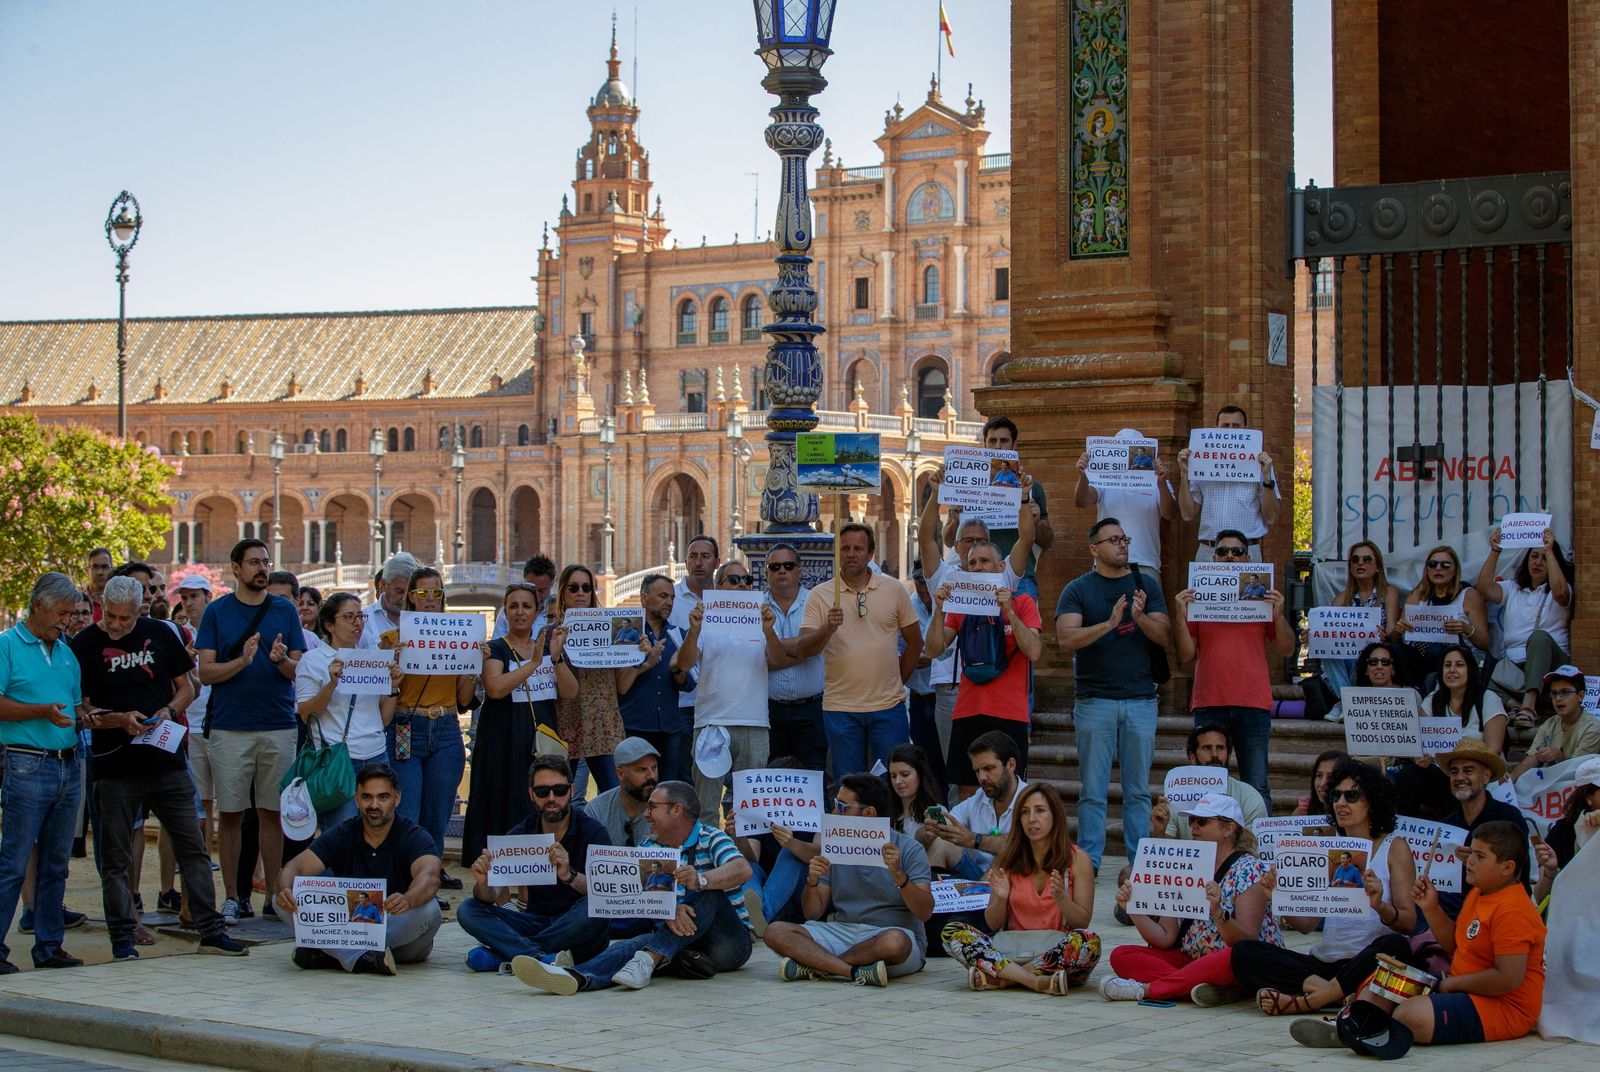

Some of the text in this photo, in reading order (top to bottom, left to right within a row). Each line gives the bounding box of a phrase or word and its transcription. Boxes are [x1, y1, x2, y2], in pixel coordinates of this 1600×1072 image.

[1201, 432, 1251, 440] SÁNCHEZ
[1194, 452, 1256, 460] ABENGOA
[946, 461, 989, 471] ¡¡CLARO
[946, 476, 987, 486] QUE SI!!
[1194, 578, 1237, 587] ¡¡CLARO
[707, 601, 759, 609] ¡¡ABENGOA
[706, 615, 760, 624] SOLUCIÓN!!
[1320, 610, 1369, 619] SÁNCHEZ
[414, 616, 472, 626] SÁNCHEZ
[407, 640, 479, 650] ABENGOA
[568, 638, 608, 647] QUE SI!!
[109, 650, 154, 672] PUMA
[341, 675, 389, 684] SOLUCIÓN!!
[1352, 697, 1392, 705] EMPRESAS
[1380, 709, 1413, 718] ENERGÍA
[1382, 722, 1408, 730] CREAN
[1381, 735, 1395, 743] LOS
[1397, 734, 1416, 743] DÍAS
[746, 774, 809, 784] SÁNCHEZ
[1168, 777, 1223, 788] ¡¡ABENGOA
[740, 798, 817, 809] ABENGOA
[825, 828, 885, 839] ¡¡ABENGOA
[1320, 840, 1367, 849] SOLUCIÓN!!
[492, 847, 550, 859] ¡¡ABENGOA
[1143, 844, 1200, 858] SÁNCHEZ
[1146, 861, 1193, 870] ESCUCHA
[1276, 856, 1326, 869] ¡¡CLARO
[493, 863, 554, 874] SOLUCIÓN!!
[591, 864, 637, 876] ¡¡CLARO
[338, 881, 381, 889] SOLUCIÓN!!
[1133, 873, 1205, 888] ABENGOA
[1278, 877, 1326, 888] QUE SI!!
[594, 882, 640, 894] QUE SI!!
[297, 894, 345, 906] ¡¡CLARO
[1158, 890, 1183, 900] ESTÁ
[1173, 905, 1204, 914] LUCHA
[300, 912, 346, 923] QUE SI!!
